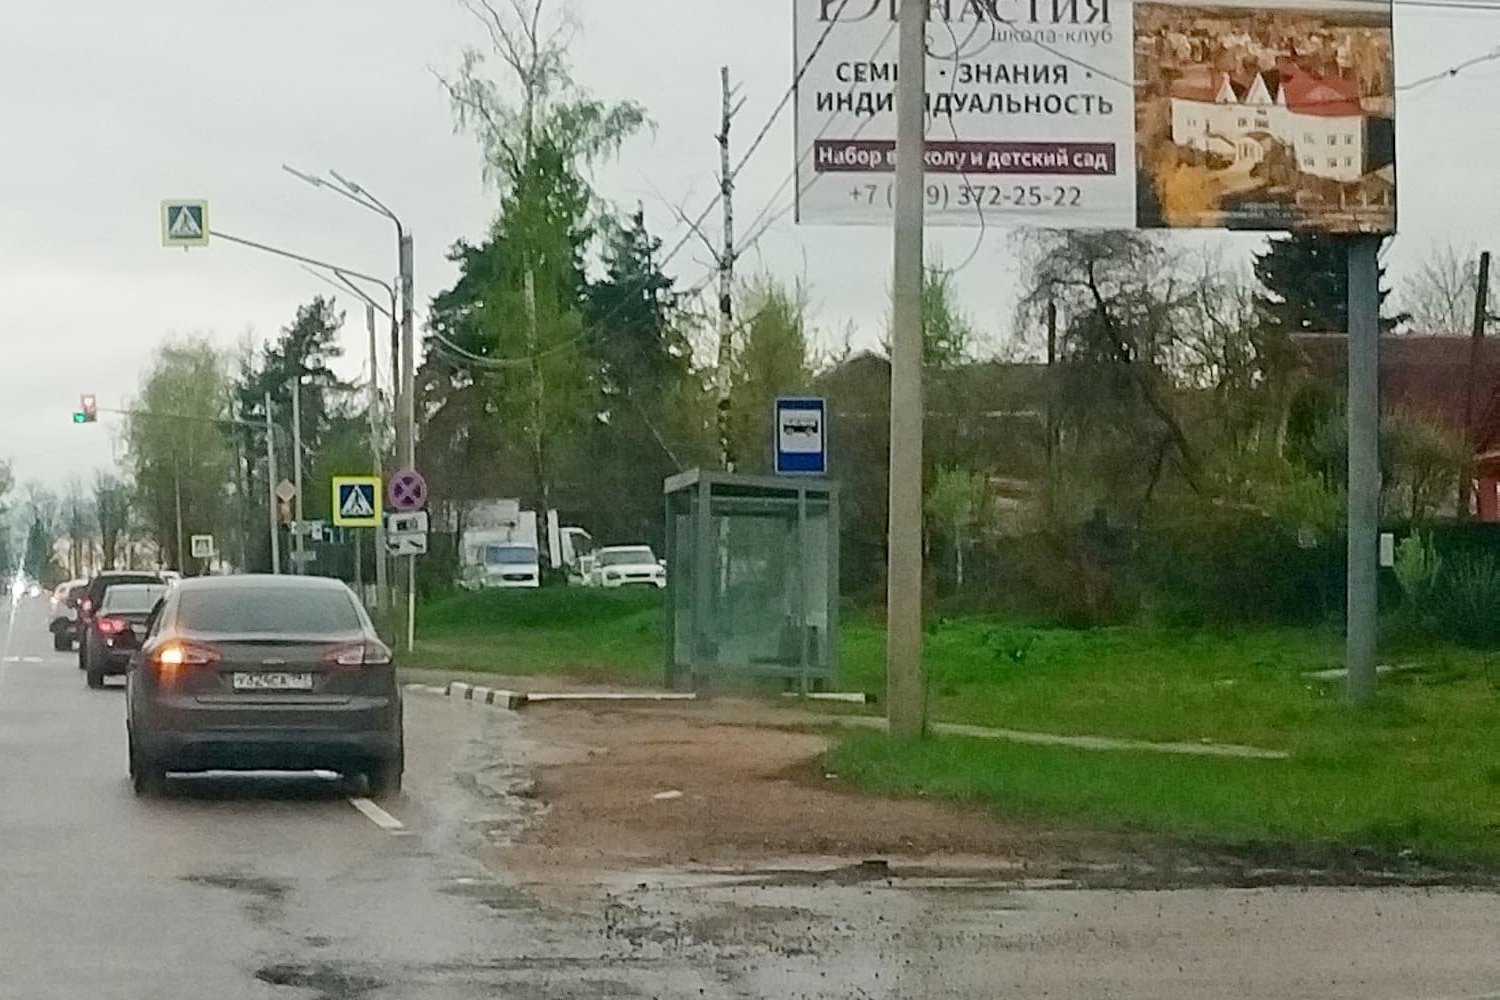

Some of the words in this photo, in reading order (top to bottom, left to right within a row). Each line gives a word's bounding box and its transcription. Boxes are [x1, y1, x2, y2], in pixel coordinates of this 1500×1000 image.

[836, 61, 899, 83] СЕМ
[958, 63, 1068, 85] ЗНАНИЯ
[816, 91, 1113, 118] ИНДИДУАЛЬНОСТЬ
[819, 146, 882, 168] Набор
[970, 151, 983, 165] и
[987, 148, 1069, 169] детский
[1073, 152, 1108, 171] сад
[851, 184, 877, 204] +7
[887, 184, 949, 209] (9)
[957, 185, 1082, 206] 372-25-22
